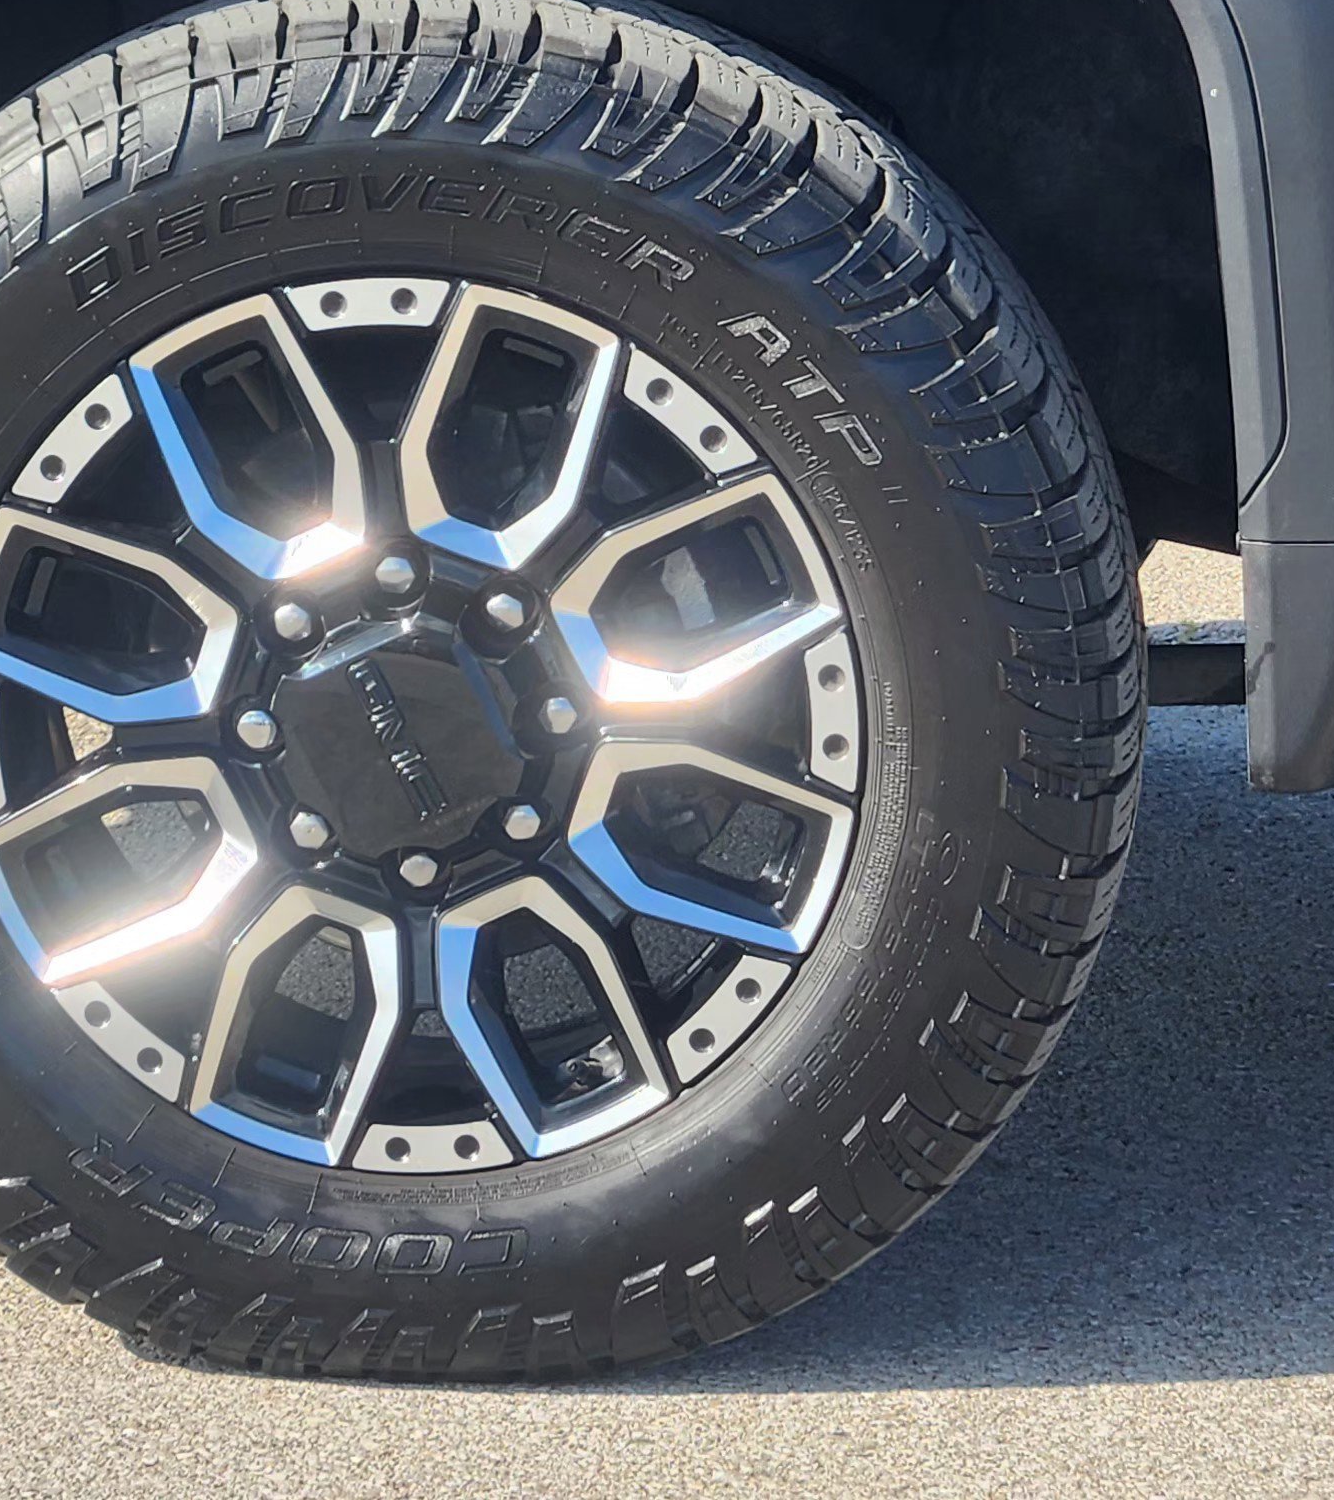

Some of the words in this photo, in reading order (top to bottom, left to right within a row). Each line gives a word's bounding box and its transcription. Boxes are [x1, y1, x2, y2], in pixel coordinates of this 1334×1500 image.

[65, 170, 697, 310] DISCOVERER
[717, 311, 883, 466] ATP
[68, 1133, 529, 1276] COOPER
